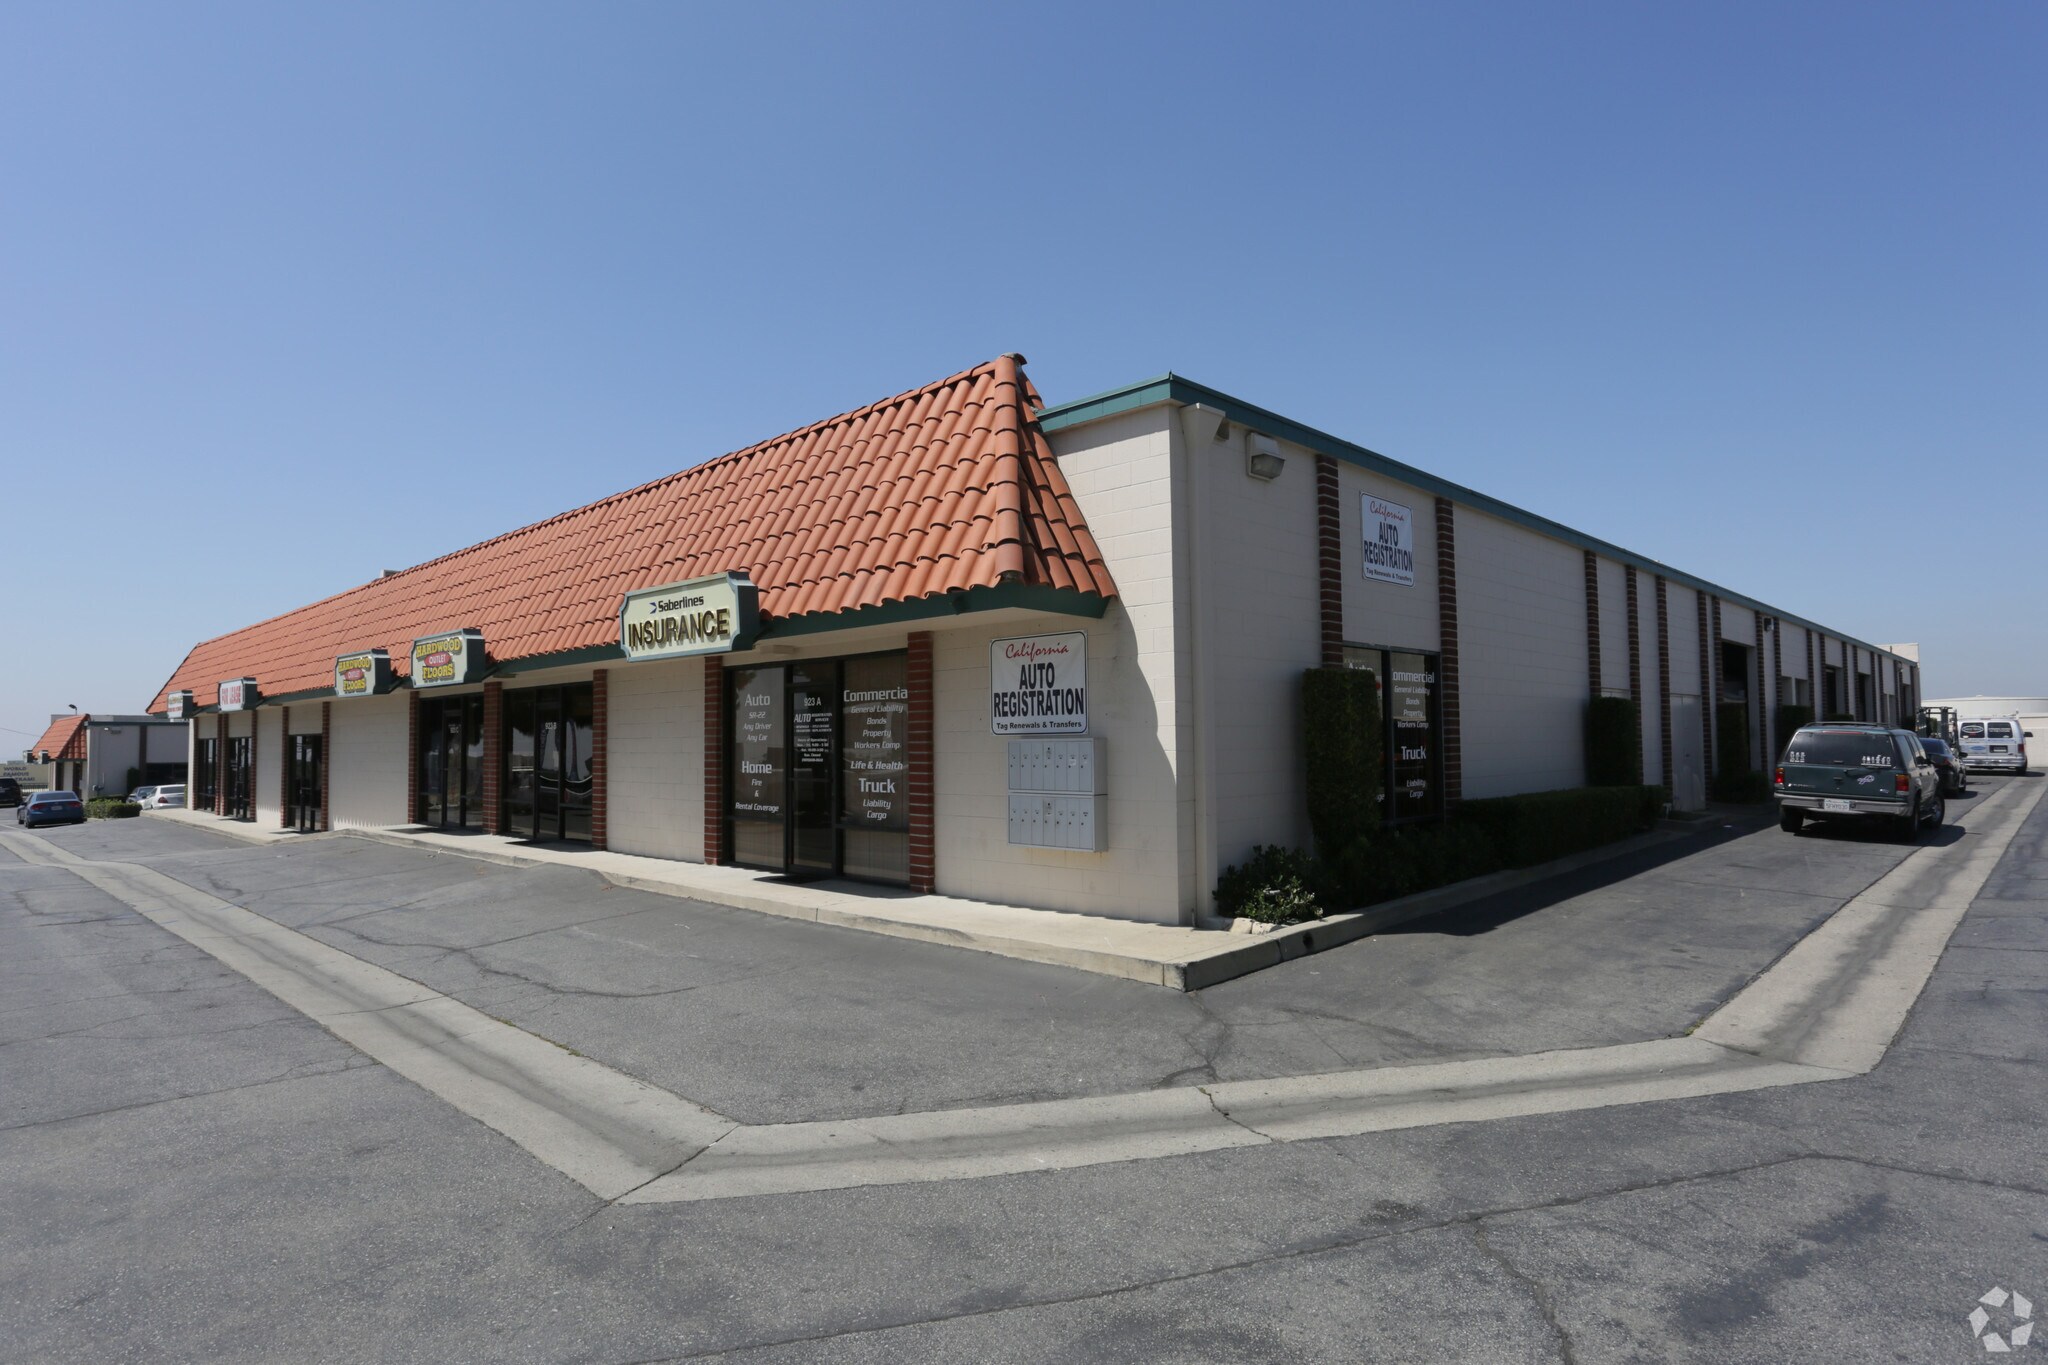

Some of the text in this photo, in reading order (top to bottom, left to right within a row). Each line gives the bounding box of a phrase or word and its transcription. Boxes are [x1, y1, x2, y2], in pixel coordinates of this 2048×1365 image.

[1370, 501, 1405, 522] California
[1379, 521, 1399, 547] AUTO
[1363, 540, 1413, 572] REGISTRATION
[1366, 567, 1374, 576] Tag
[658, 595, 705, 613] Saberlines
[628, 608, 731, 649] INSURANCE
[416, 637, 461, 659] HARDWOOD
[1005, 642, 1070, 663] California
[338, 656, 370, 674] HARDWOOD
[428, 654, 446, 665] OUTLET
[422, 664, 454, 681] FLOORS
[1019, 662, 1055, 690] AUTO
[1392, 670, 1435, 684] ommercial
[343, 677, 366, 691] FLOORS
[744, 693, 771, 707] Auto
[843, 687, 909, 702] Commercia
[803, 696, 822, 707] 923 A
[993, 688, 1085, 718] REGISTRATION
[748, 711, 766, 719] SR-22
[850, 705, 904, 714] General Liability
[793, 713, 812, 723] AUTO
[866, 717, 888, 725] Bonds
[742, 722, 772, 732] Any Driver
[996, 722, 1009, 731] Tag
[1049, 720, 1082, 728] Transfers
[746, 733, 768, 742] Any Car
[862, 729, 892, 738] Property
[854, 741, 901, 750] Workers Comp
[1400, 745, 1427, 760] Truck
[741, 760, 773, 774] Home
[850, 760, 904, 770] Life & Health
[751, 778, 763, 787] Fire
[858, 777, 896, 794] Truck
[1406, 778, 1427, 788] Liability
[754, 790, 759, 798] &
[1409, 789, 1424, 800] Cargo
[735, 802, 779, 814] Rental Coverage
[862, 798, 892, 810] Liability
[866, 810, 888, 821] Cargo
